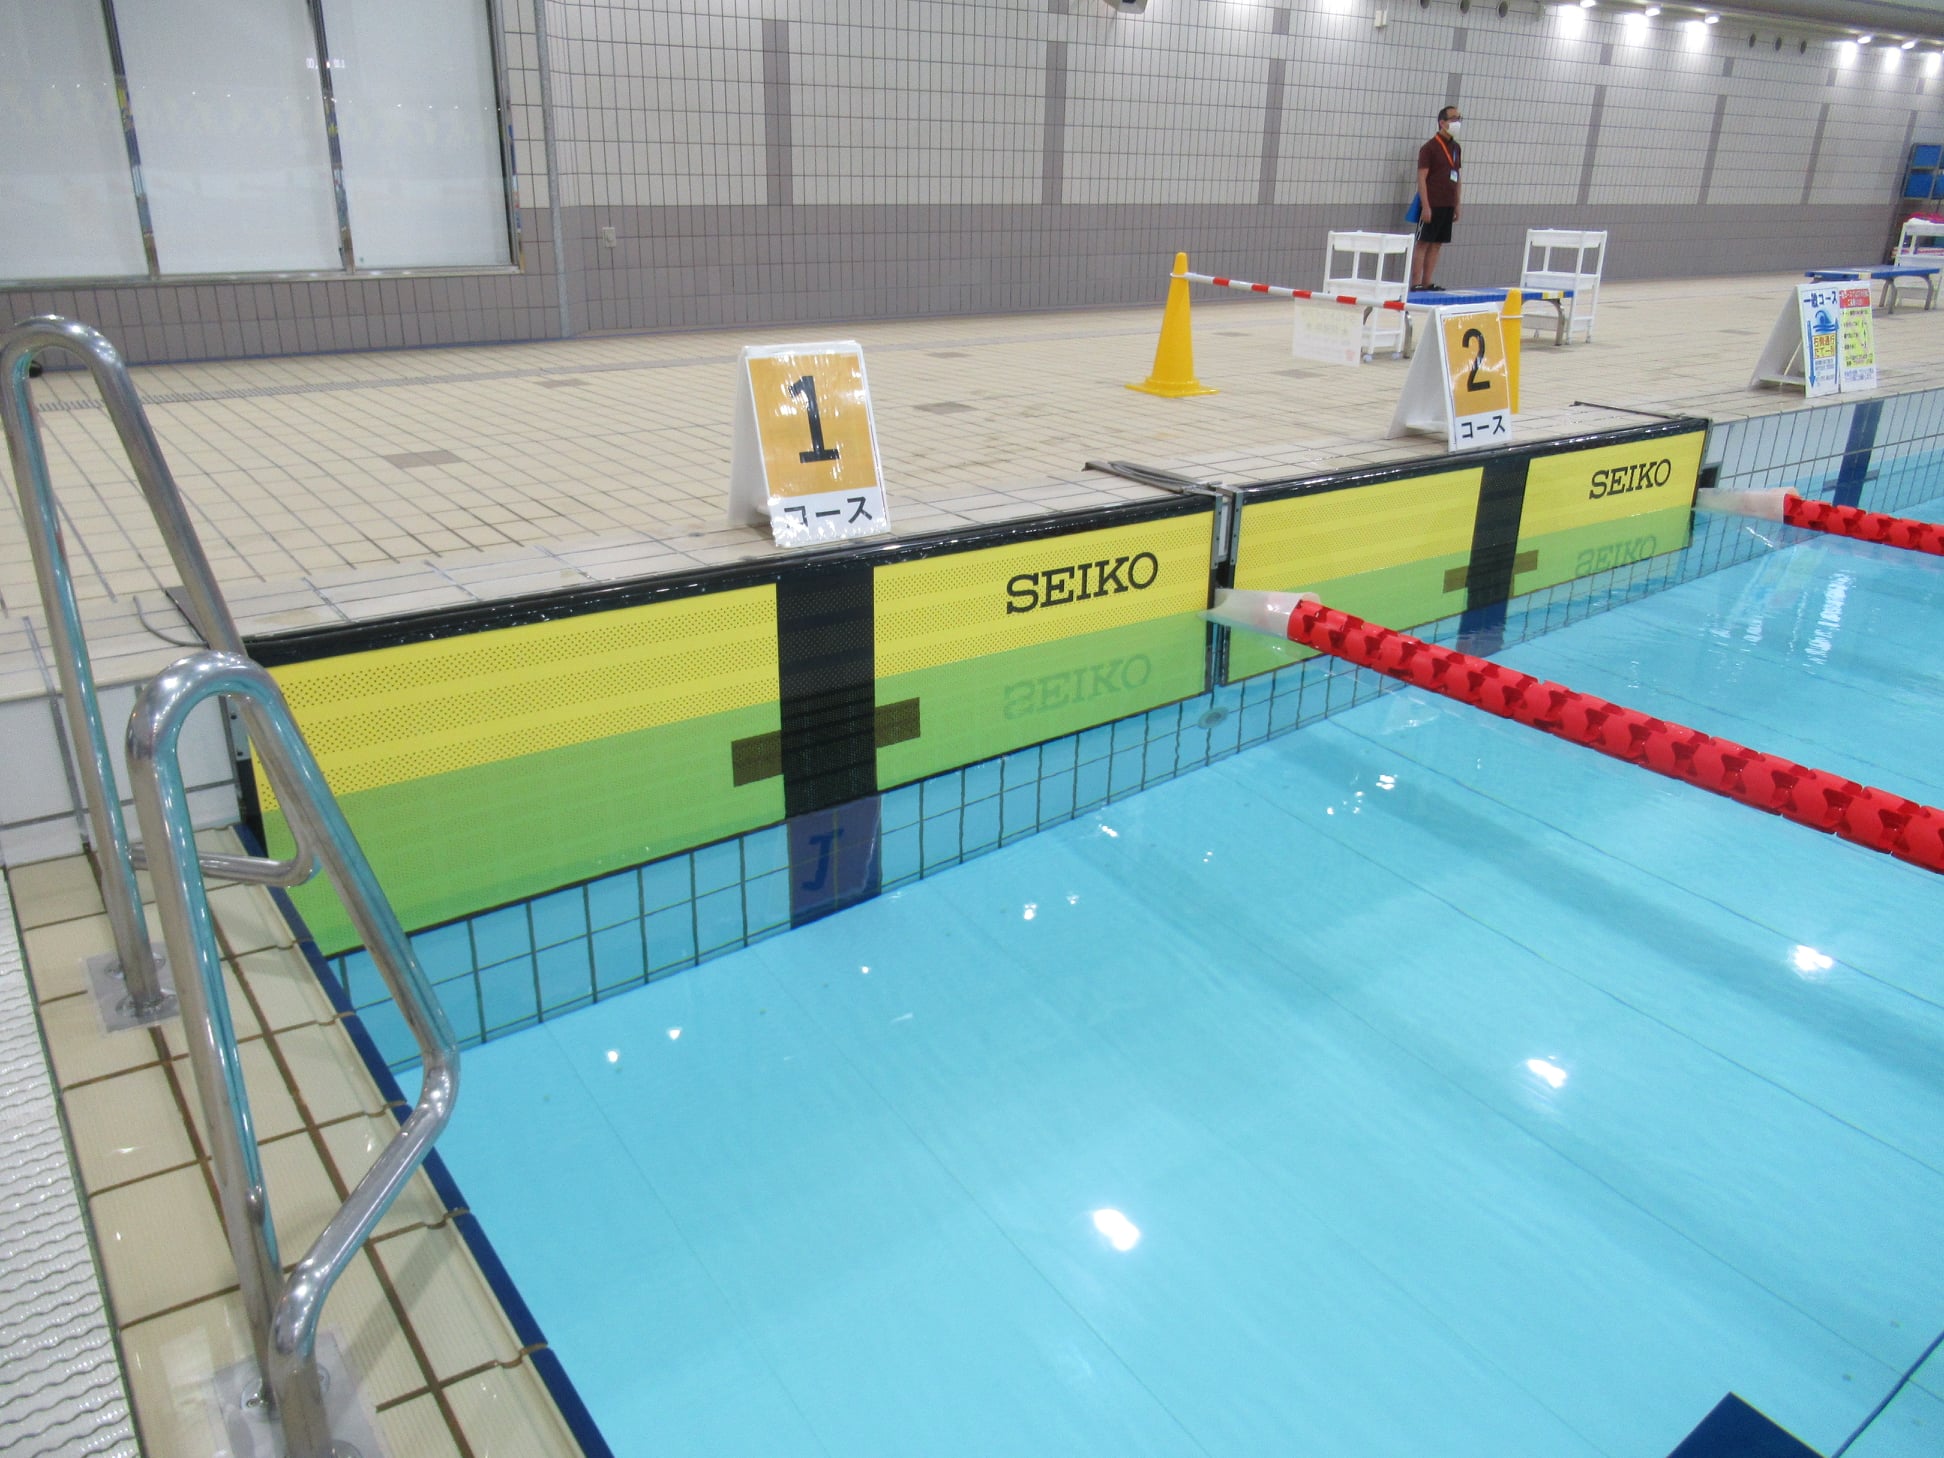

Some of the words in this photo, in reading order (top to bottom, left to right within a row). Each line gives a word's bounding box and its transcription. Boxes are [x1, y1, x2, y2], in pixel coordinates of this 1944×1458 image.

[1461, 328, 1491, 393] 2
[787, 375, 841, 464] 1
[1460, 415, 1506, 439] コース
[1588, 458, 1672, 500] SEIKO
[783, 495, 873, 529] コース
[1005, 551, 1159, 615] SEIKO
